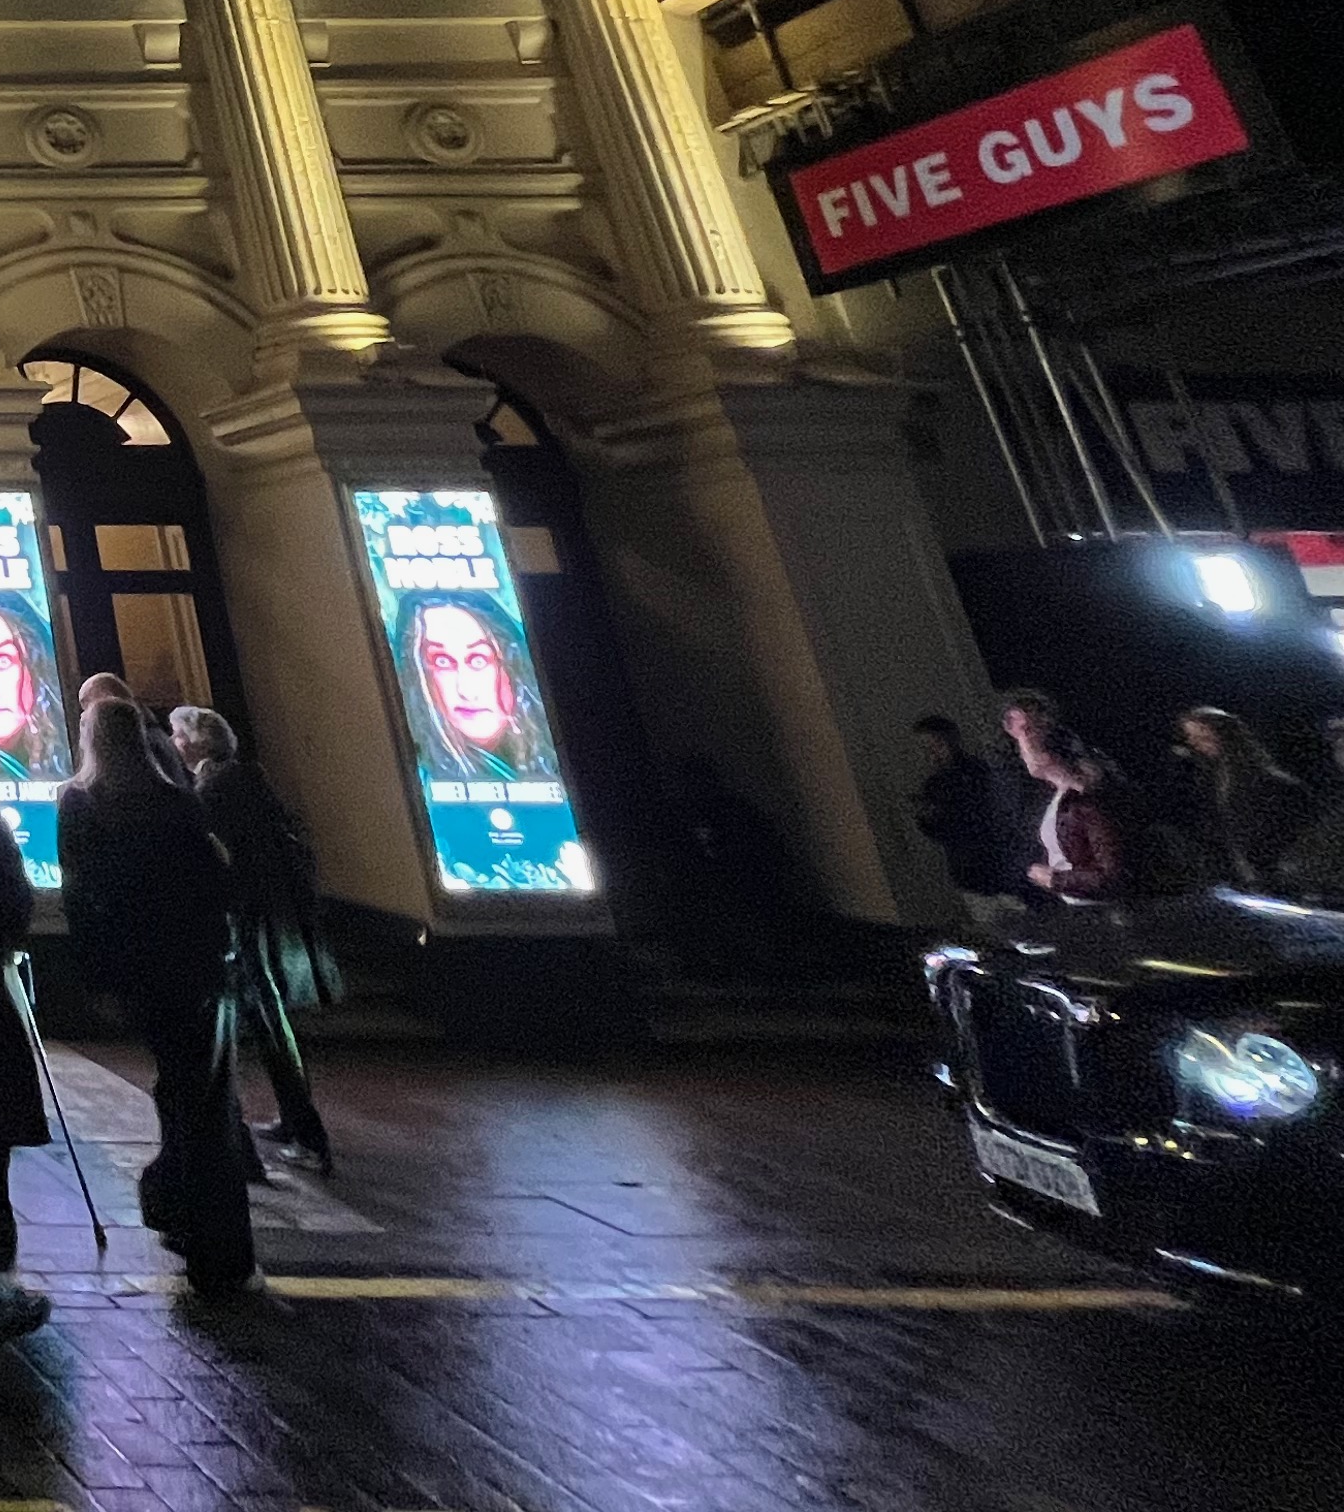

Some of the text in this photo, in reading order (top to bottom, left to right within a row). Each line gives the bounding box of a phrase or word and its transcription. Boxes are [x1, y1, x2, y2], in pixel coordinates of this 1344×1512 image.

[817, 73, 1195, 238] FIVE GUYS
[1129, 400, 1344, 472] FIV
